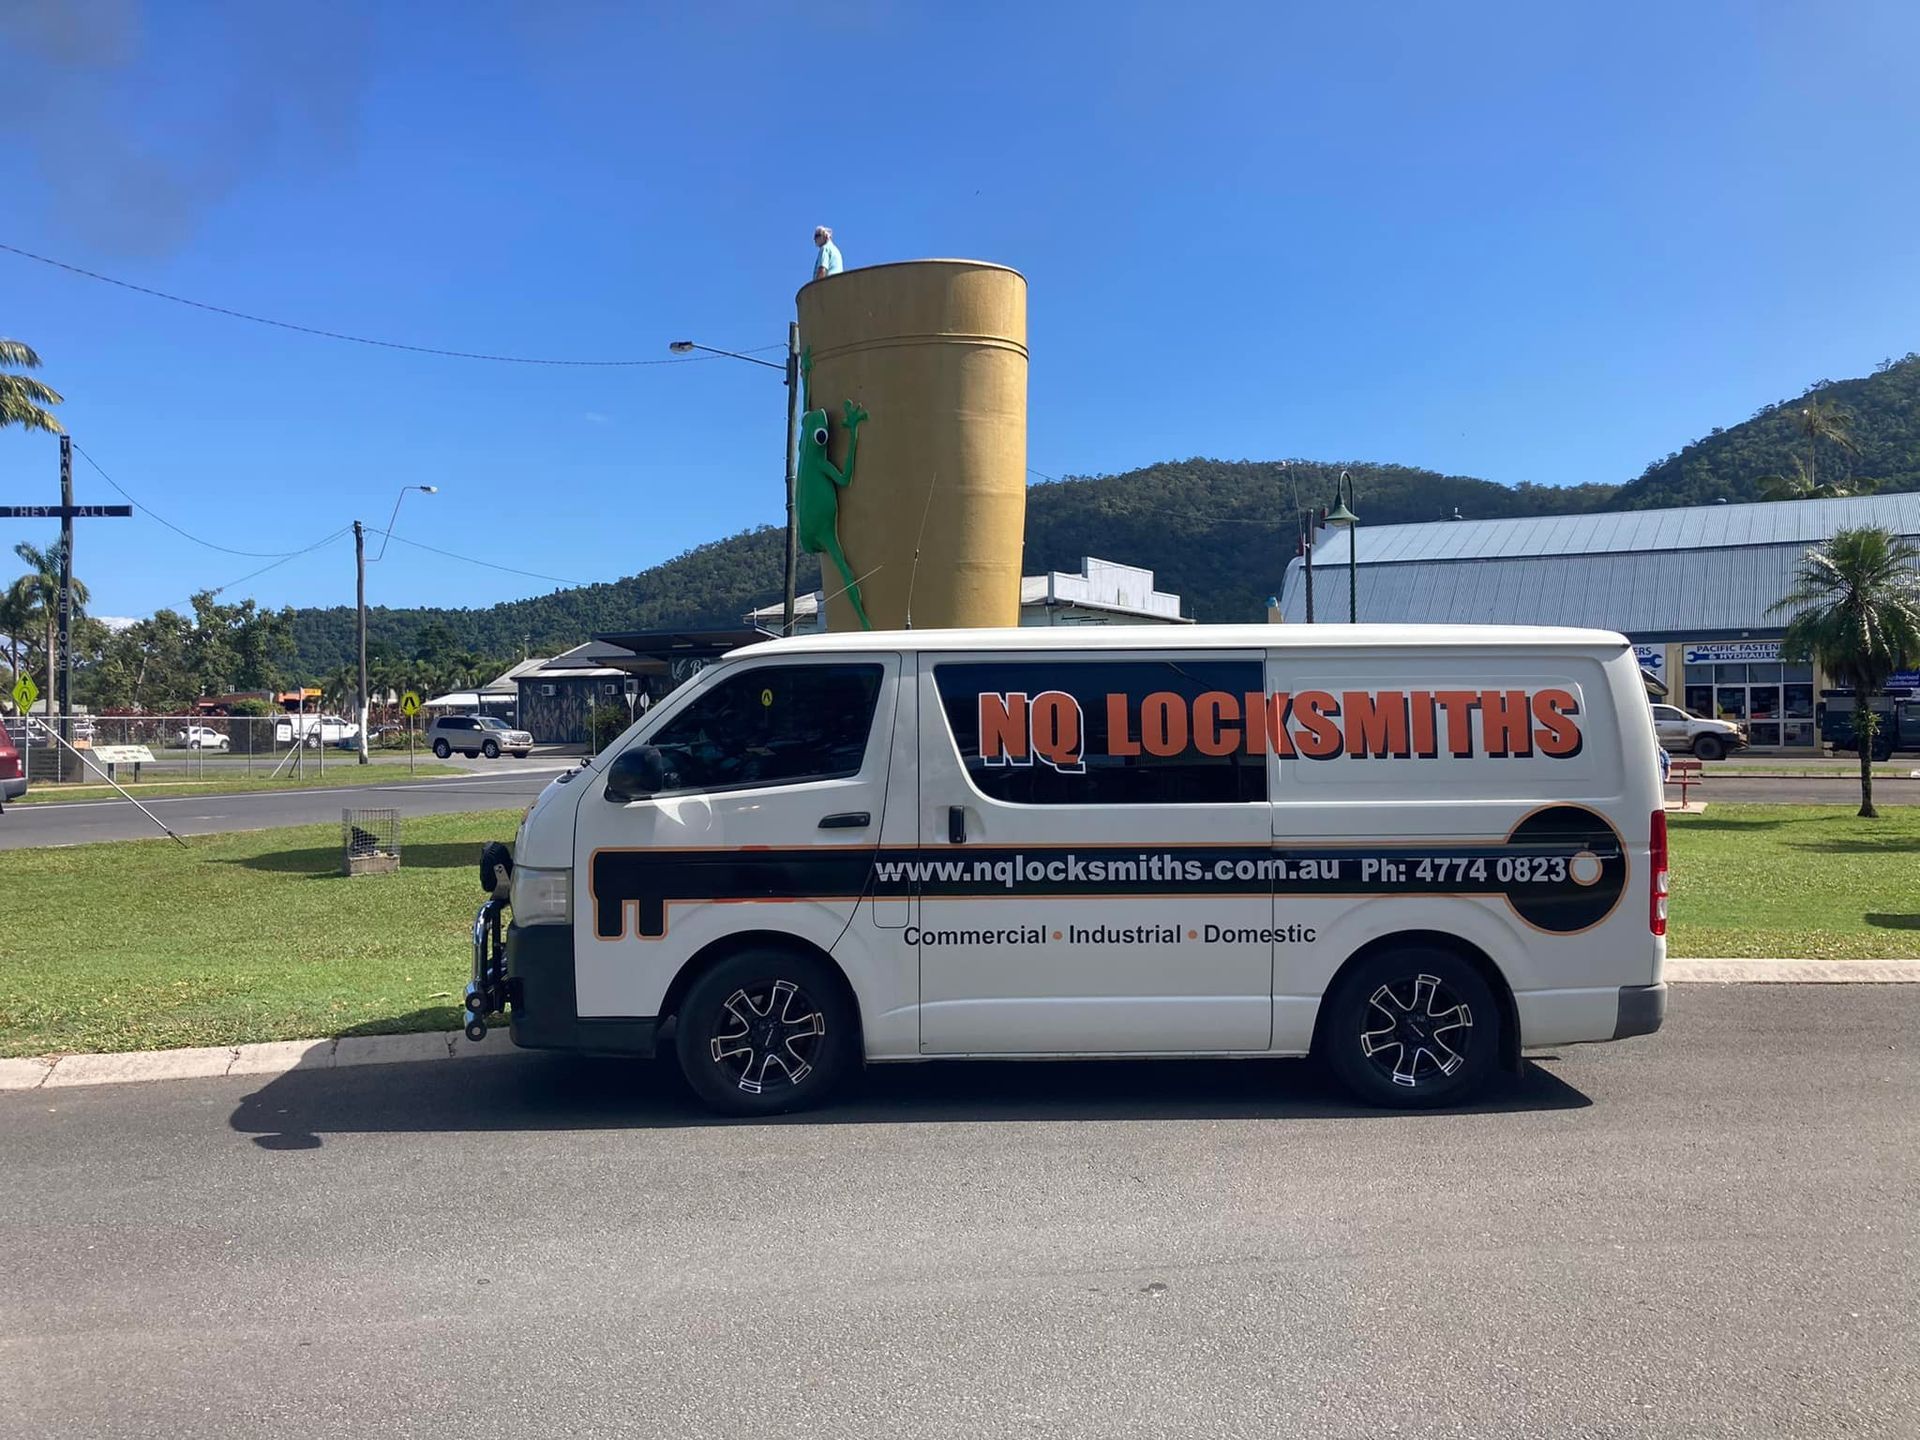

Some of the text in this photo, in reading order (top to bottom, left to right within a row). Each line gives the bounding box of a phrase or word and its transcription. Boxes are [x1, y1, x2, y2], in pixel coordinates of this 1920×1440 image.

[9, 506, 110, 517] THEY ALL
[59, 438, 70, 671] THAT MAY BE ONE
[1696, 644, 1736, 653] PACIFIC
[978, 689, 1583, 775] NQ LOCKSMITHS
[875, 854, 1567, 888] www.nqlocksmiths.com.au Ph: 4774 0823
[904, 923, 1317, 946] Commercial Industrial Domestic
